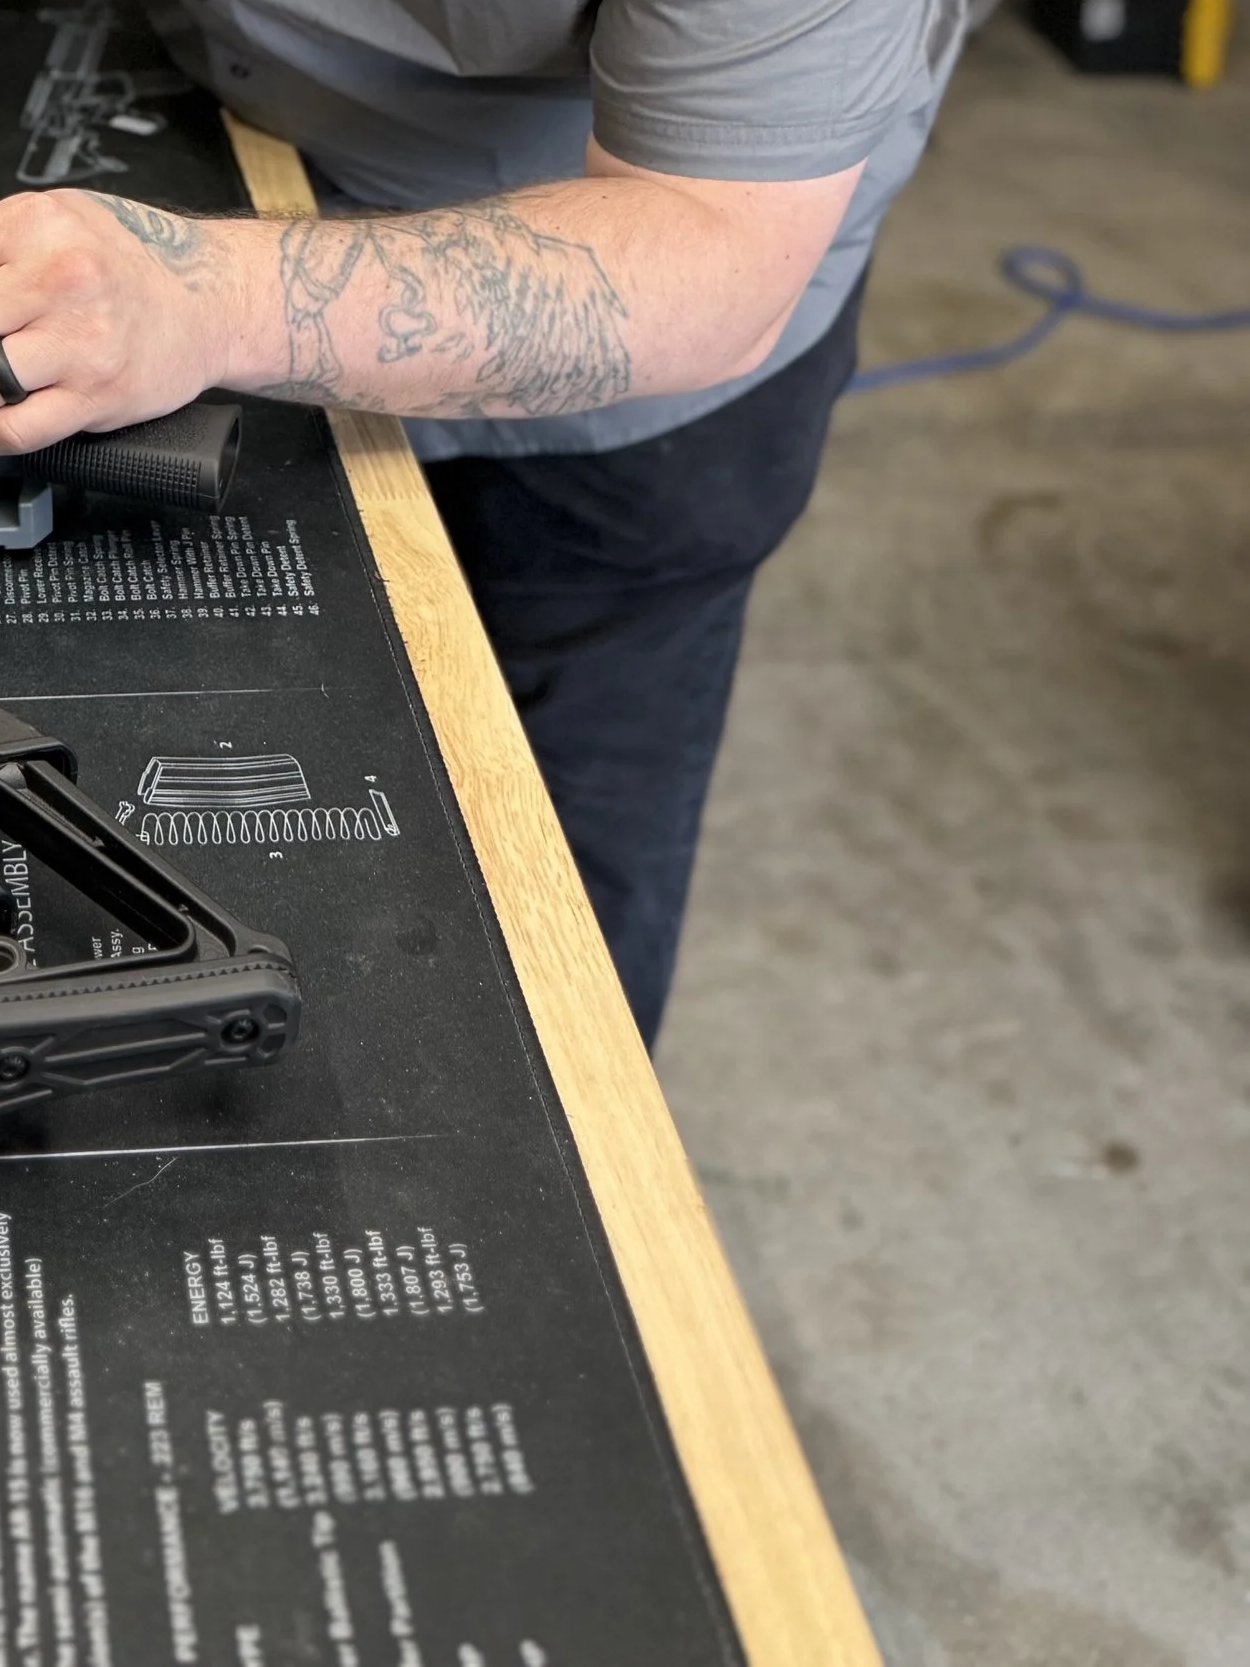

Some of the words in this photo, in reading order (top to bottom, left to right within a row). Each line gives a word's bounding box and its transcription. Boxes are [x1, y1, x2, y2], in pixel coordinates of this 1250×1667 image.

[286, 520, 300, 544] Spring
[276, 546, 292, 570] Detent
[292, 546, 308, 570] Detent
[285, 572, 299, 596] Safety
[300, 570, 315, 596] Safety
[220, 740, 232, 749] 2
[364, 774, 378, 782] 4
[269, 851, 283, 859] 3
[208, 1238, 230, 1278] ft-lbf
[238, 1253, 259, 1270] J)
[261, 1234, 283, 1274] ft-lbf
[291, 1250, 312, 1268] J)
[313, 1232, 336, 1271] ft-lbf
[343, 1248, 365, 1264] J)
[449, 1242, 470, 1258] J)
[25, 1257, 48, 1340] available)
[184, 1251, 209, 1325] ENERGY
[322, 1274, 346, 1319] 1,330
[57, 1294, 78, 1340] rifles.
[0, 1302, 18, 1362] almost
[64, 1343, 85, 1407] assault
[2, 1367, 22, 1410] used
